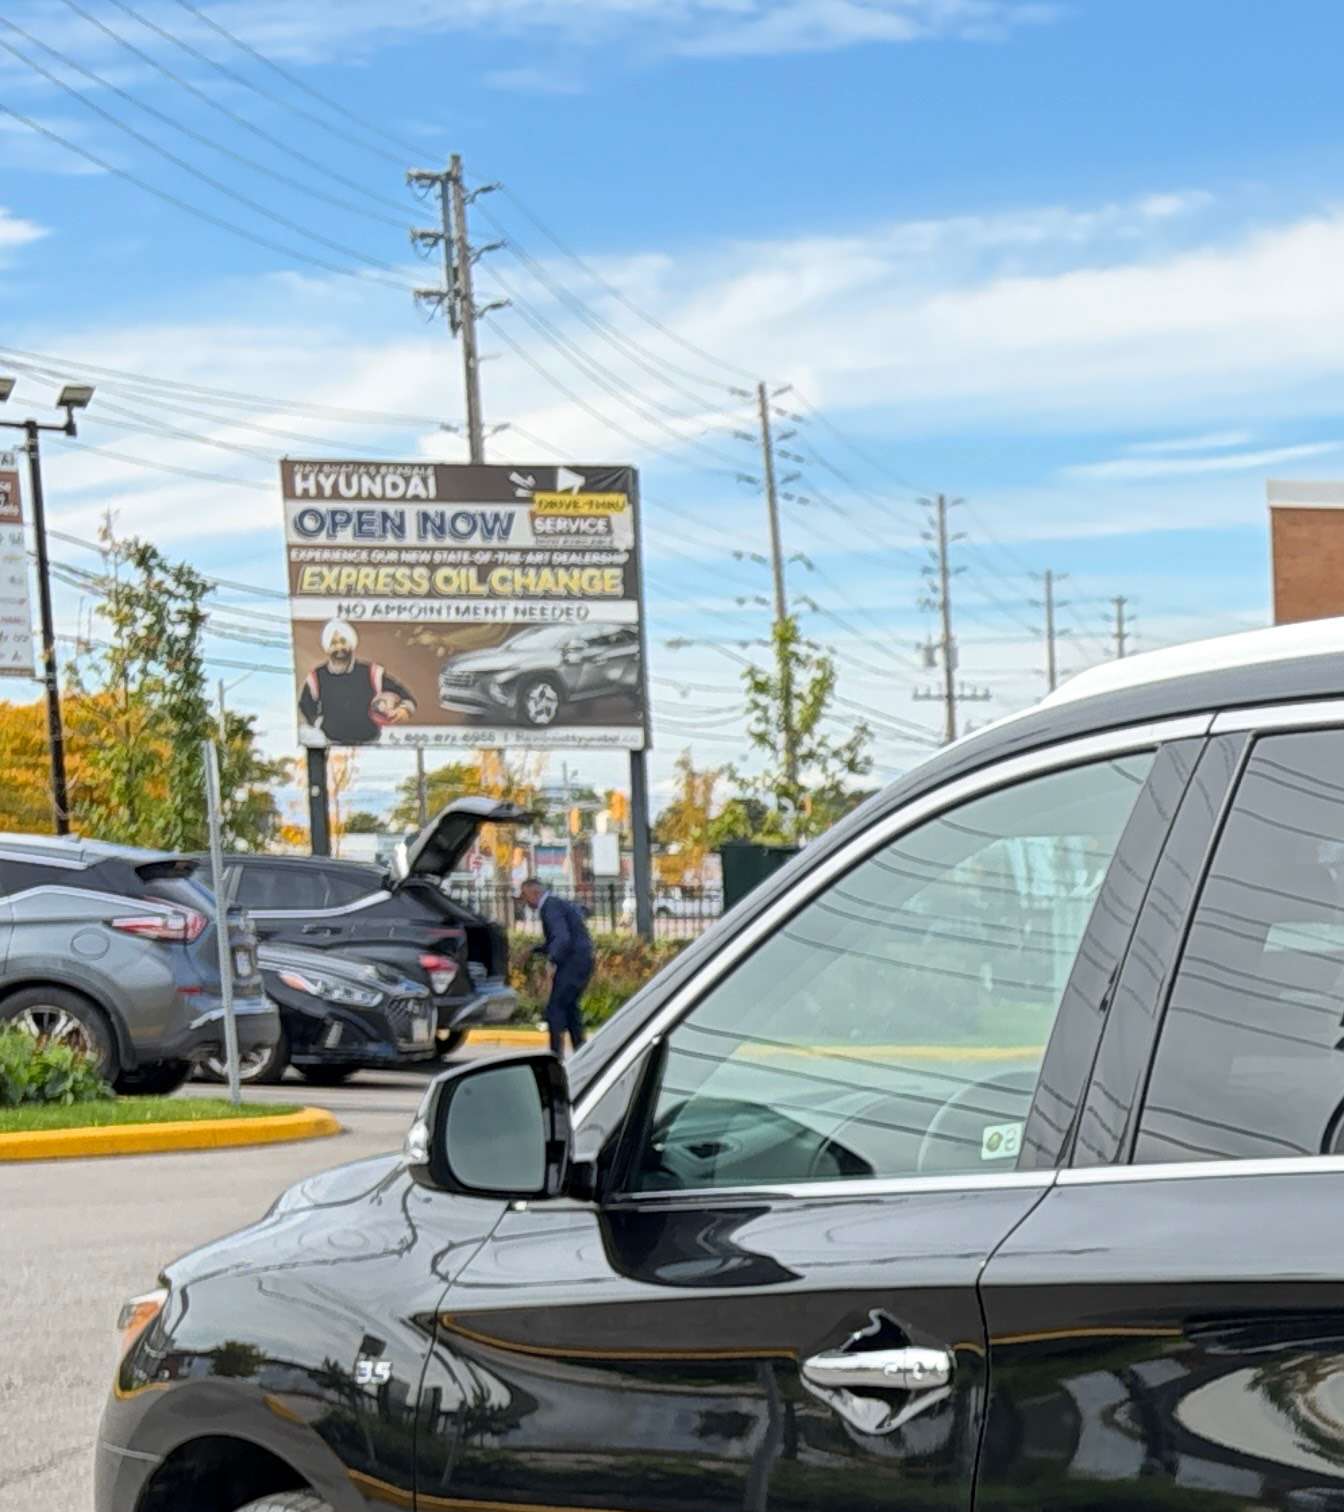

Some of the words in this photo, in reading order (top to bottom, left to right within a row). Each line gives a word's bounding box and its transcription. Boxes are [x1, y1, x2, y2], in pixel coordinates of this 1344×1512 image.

[294, 472, 437, 499] HYUNDAI
[294, 509, 407, 541] OPEN
[417, 510, 516, 541] NOW
[534, 517, 609, 534] SERVICE
[290, 548, 369, 563] EXPERIENCE
[370, 549, 400, 563] OUR
[400, 549, 432, 564] NEW
[552, 552, 629, 566] DEALERSHIP
[298, 565, 431, 596] EXPRESS
[432, 567, 487, 597] OIL
[488, 567, 624, 597] CHANGE
[337, 603, 366, 618] NO
[371, 604, 506, 618] APPOINTMENT
[513, 604, 590, 620] NEEDED
